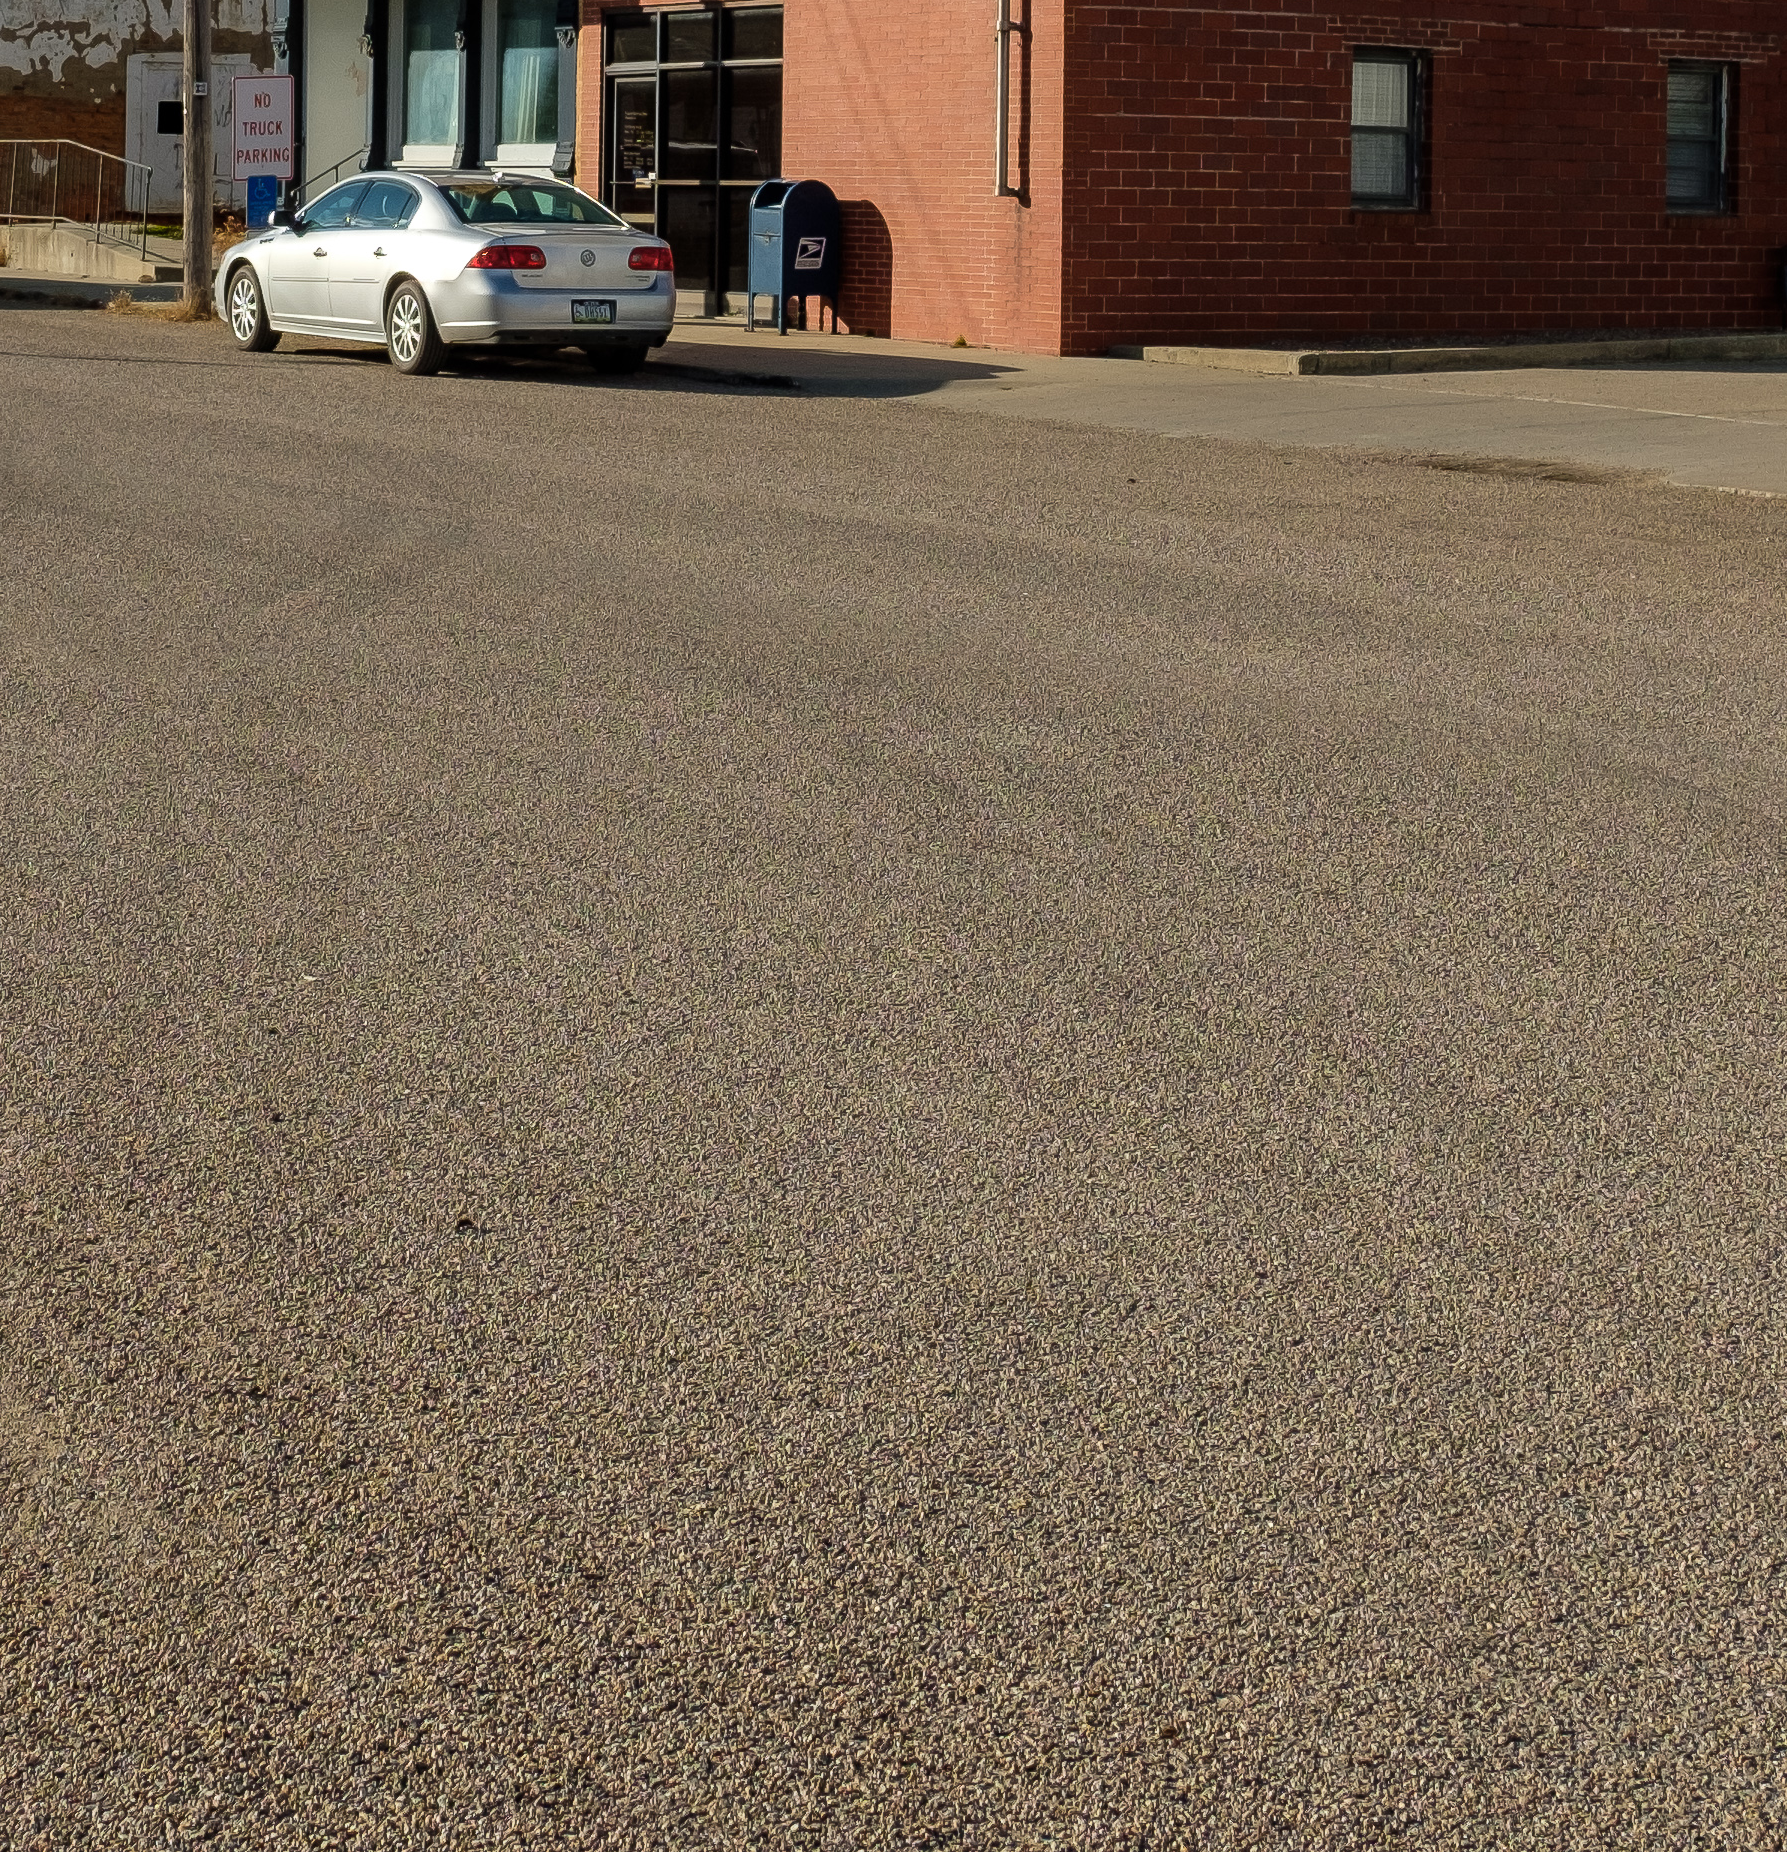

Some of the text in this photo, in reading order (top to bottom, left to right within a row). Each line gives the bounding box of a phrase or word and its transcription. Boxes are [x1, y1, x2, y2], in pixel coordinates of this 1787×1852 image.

[254, 92, 272, 108] NO
[243, 121, 283, 137] TRUCK
[237, 147, 290, 164] PARKING
